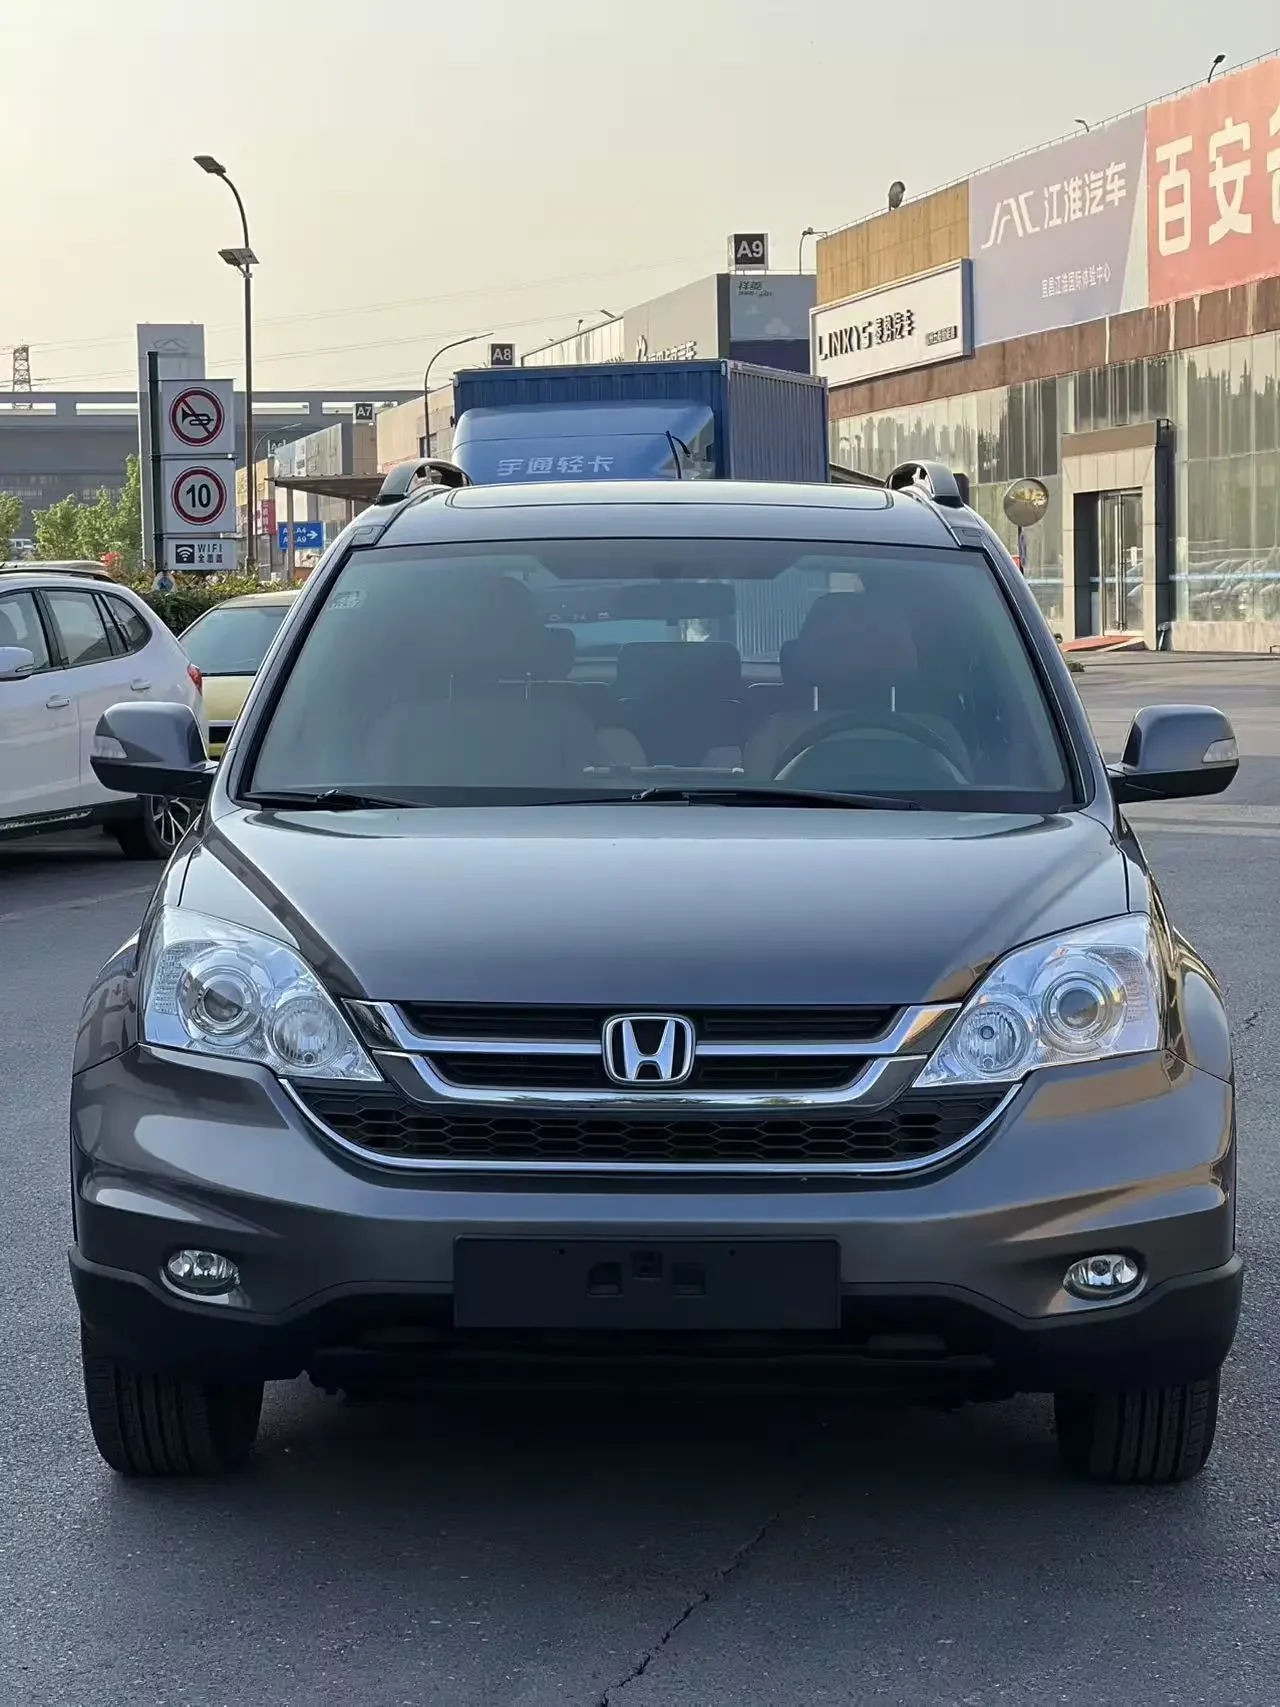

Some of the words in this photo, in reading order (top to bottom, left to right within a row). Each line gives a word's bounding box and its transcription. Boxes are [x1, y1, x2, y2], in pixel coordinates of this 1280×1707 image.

[1043, 161, 1127, 229] 江淮汽车
[736, 240, 763, 258] A9
[492, 348, 512, 361] A8
[356, 406, 372, 417] A7
[496, 455, 615, 477] 宇通轻卡
[186, 483, 211, 509] 10
[197, 543, 223, 553] WIFI
